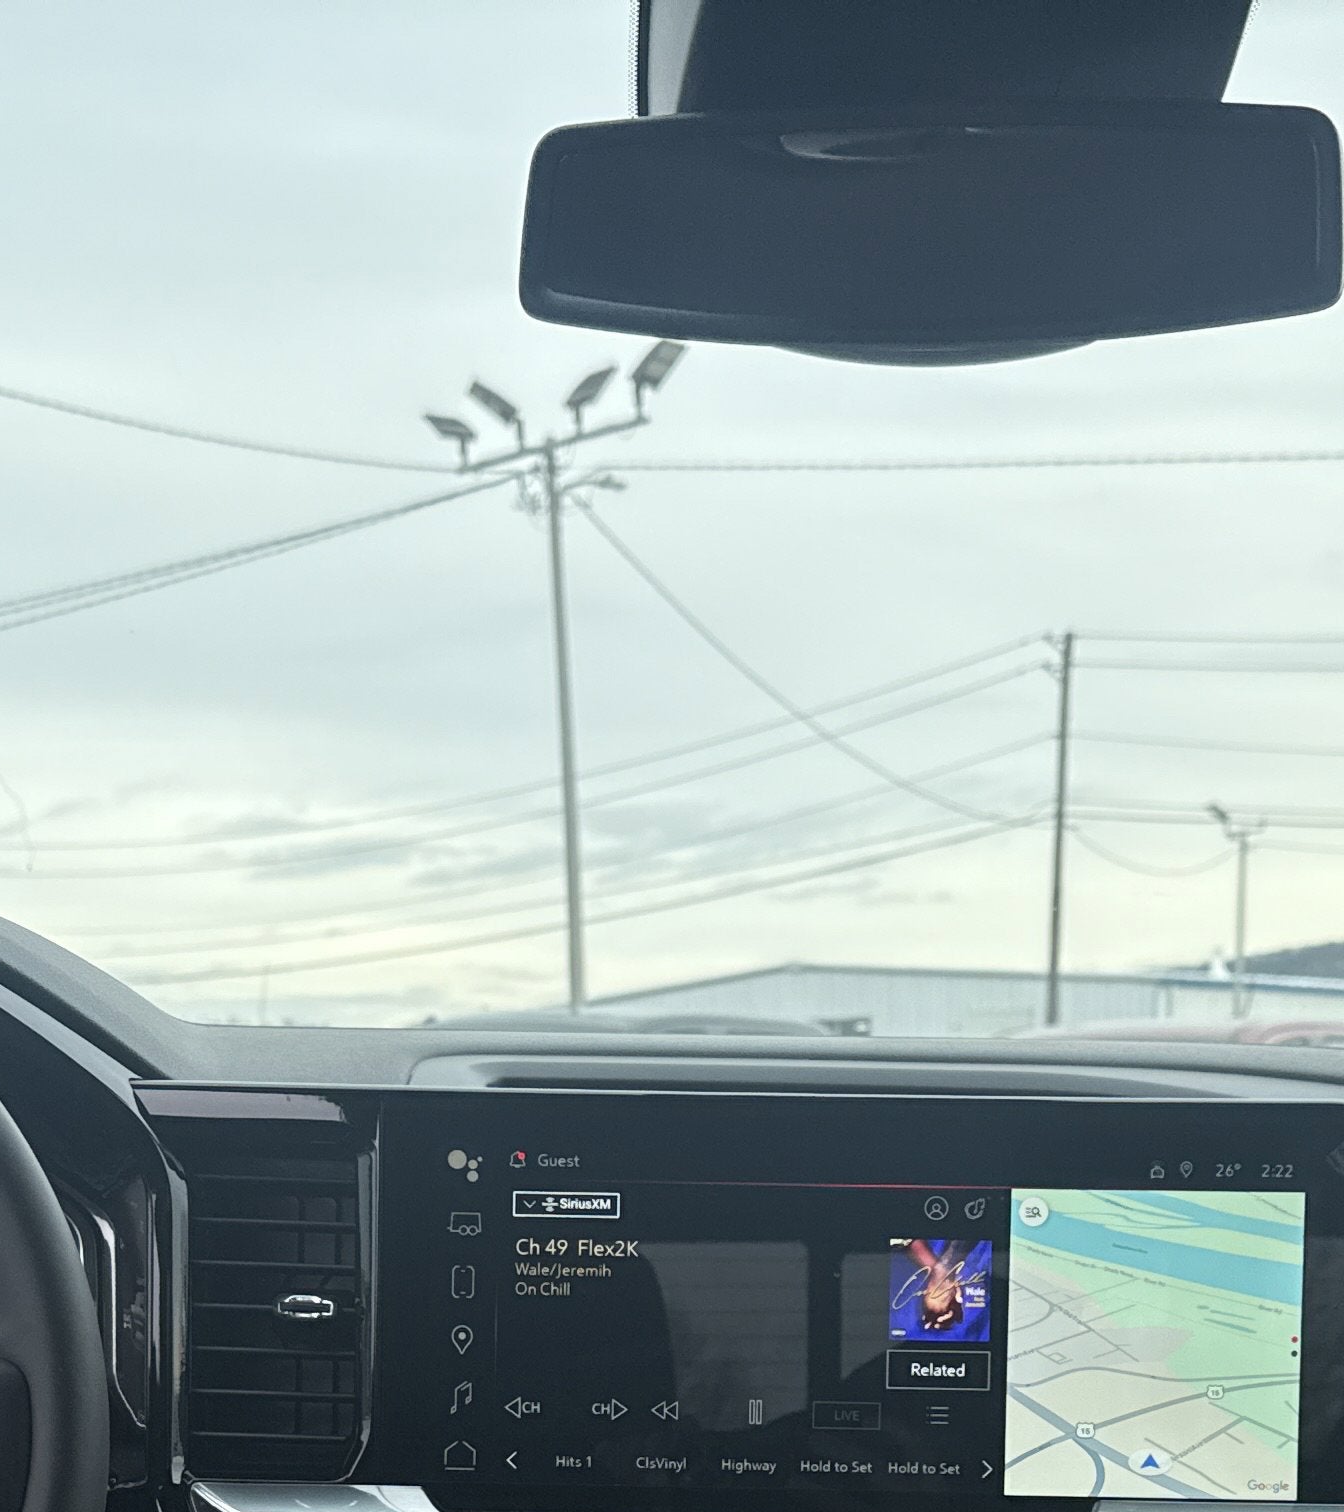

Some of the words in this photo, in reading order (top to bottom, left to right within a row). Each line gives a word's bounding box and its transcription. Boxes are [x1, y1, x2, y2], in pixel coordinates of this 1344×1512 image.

[537, 1153, 580, 1168] Guest
[1261, 1164, 1294, 1179] 2:22
[559, 1197, 611, 1210] SiriusXM
[515, 1239, 541, 1256] Ch
[545, 1240, 568, 1256] 49
[577, 1239, 639, 1258] Flex2K
[515, 1262, 612, 1279] Wale/Jeremih
[515, 1283, 536, 1297] On
[540, 1282, 570, 1297] Chill
[910, 1362, 966, 1378] Related
[522, 1402, 541, 1414] CH
[591, 1403, 612, 1416] CH
[835, 1409, 860, 1422] LIVE
[556, 1455, 581, 1469] Hits
[586, 1456, 593, 1469] 1
[636, 1456, 687, 1472] ClsVinyl
[721, 1458, 777, 1474] Highway
[800, 1460, 831, 1473] Hold
[834, 1461, 848, 1474] to
[851, 1460, 873, 1474] Set
[887, 1461, 919, 1475] Hold
[922, 1462, 935, 1475] to
[938, 1461, 960, 1476] Set
[1246, 1479, 1290, 1493] Google
